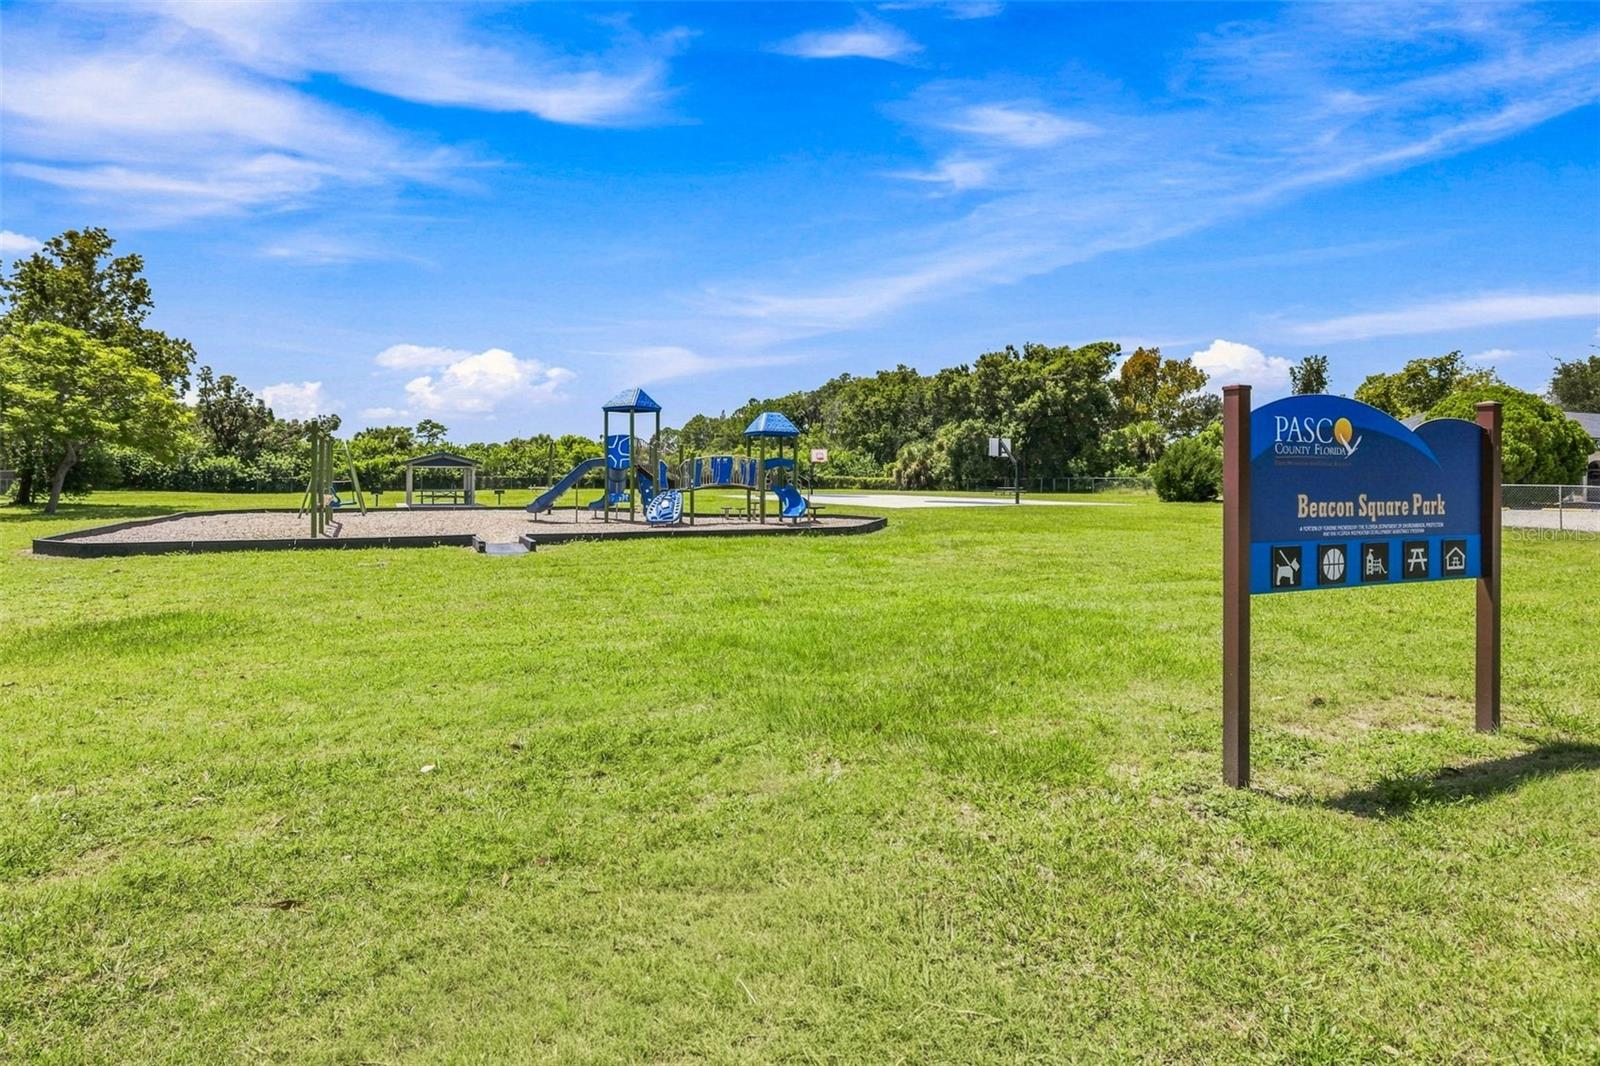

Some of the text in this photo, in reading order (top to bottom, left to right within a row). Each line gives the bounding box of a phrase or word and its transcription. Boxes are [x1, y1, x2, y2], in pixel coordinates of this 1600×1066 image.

[1274, 415, 1353, 445] PASCO
[1297, 493, 1446, 522] Beacon Square Park
